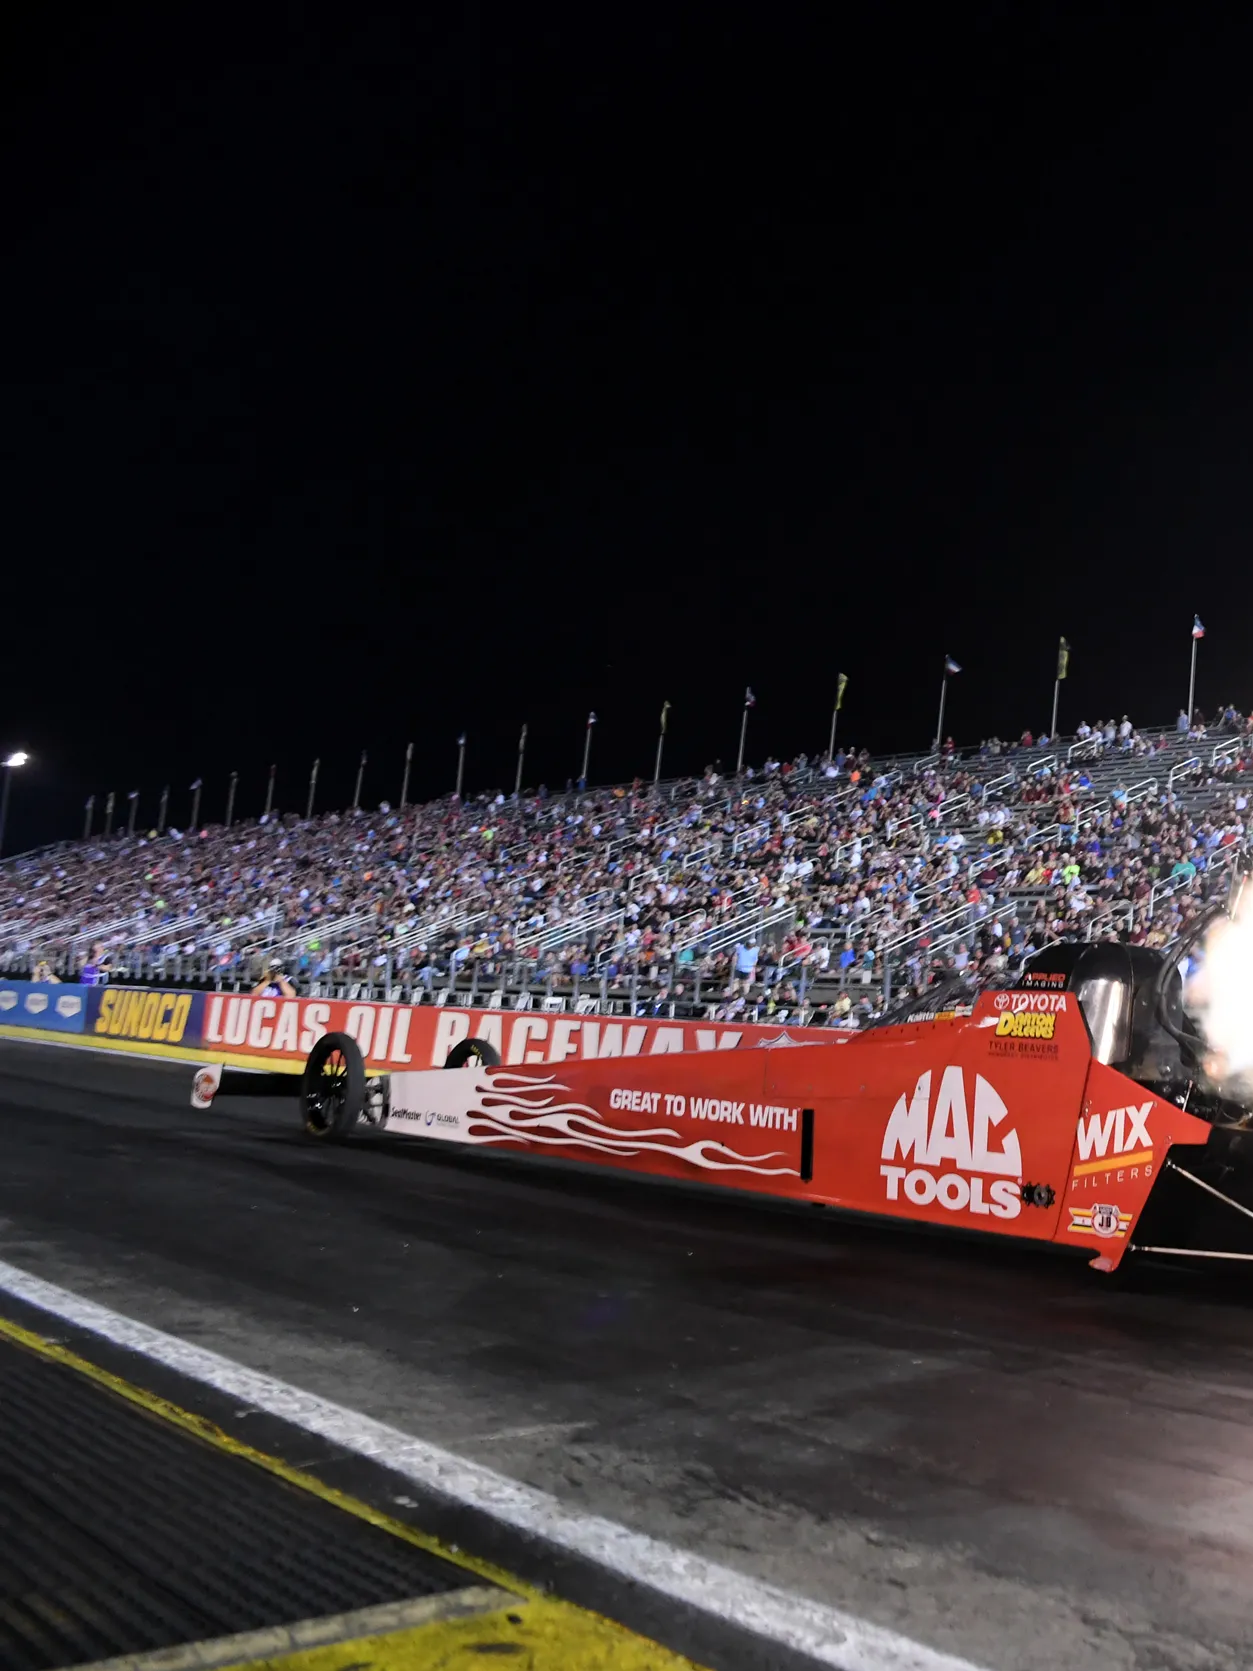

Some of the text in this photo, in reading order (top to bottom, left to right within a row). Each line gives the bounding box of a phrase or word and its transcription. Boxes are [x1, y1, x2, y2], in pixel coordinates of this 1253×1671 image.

[1022, 980, 1064, 988] IMAGING
[1025, 973, 1066, 982] APPLIED
[95, 989, 193, 1042] SUNOCO
[1011, 993, 1067, 1012] TOYOTA
[205, 996, 743, 1068] LUCAS OIL RACEWAY
[989, 1041, 1059, 1054] TYLER BEAVERS
[437, 1113, 460, 1124] GLOBAL
[609, 1088, 798, 1132] GREAT TO WORK WITH
[880, 1065, 1023, 1177] MAC
[1077, 1101, 1154, 1161] WIX
[880, 1165, 1022, 1219] TOOLS
[1071, 1165, 1153, 1191] FILTERS
